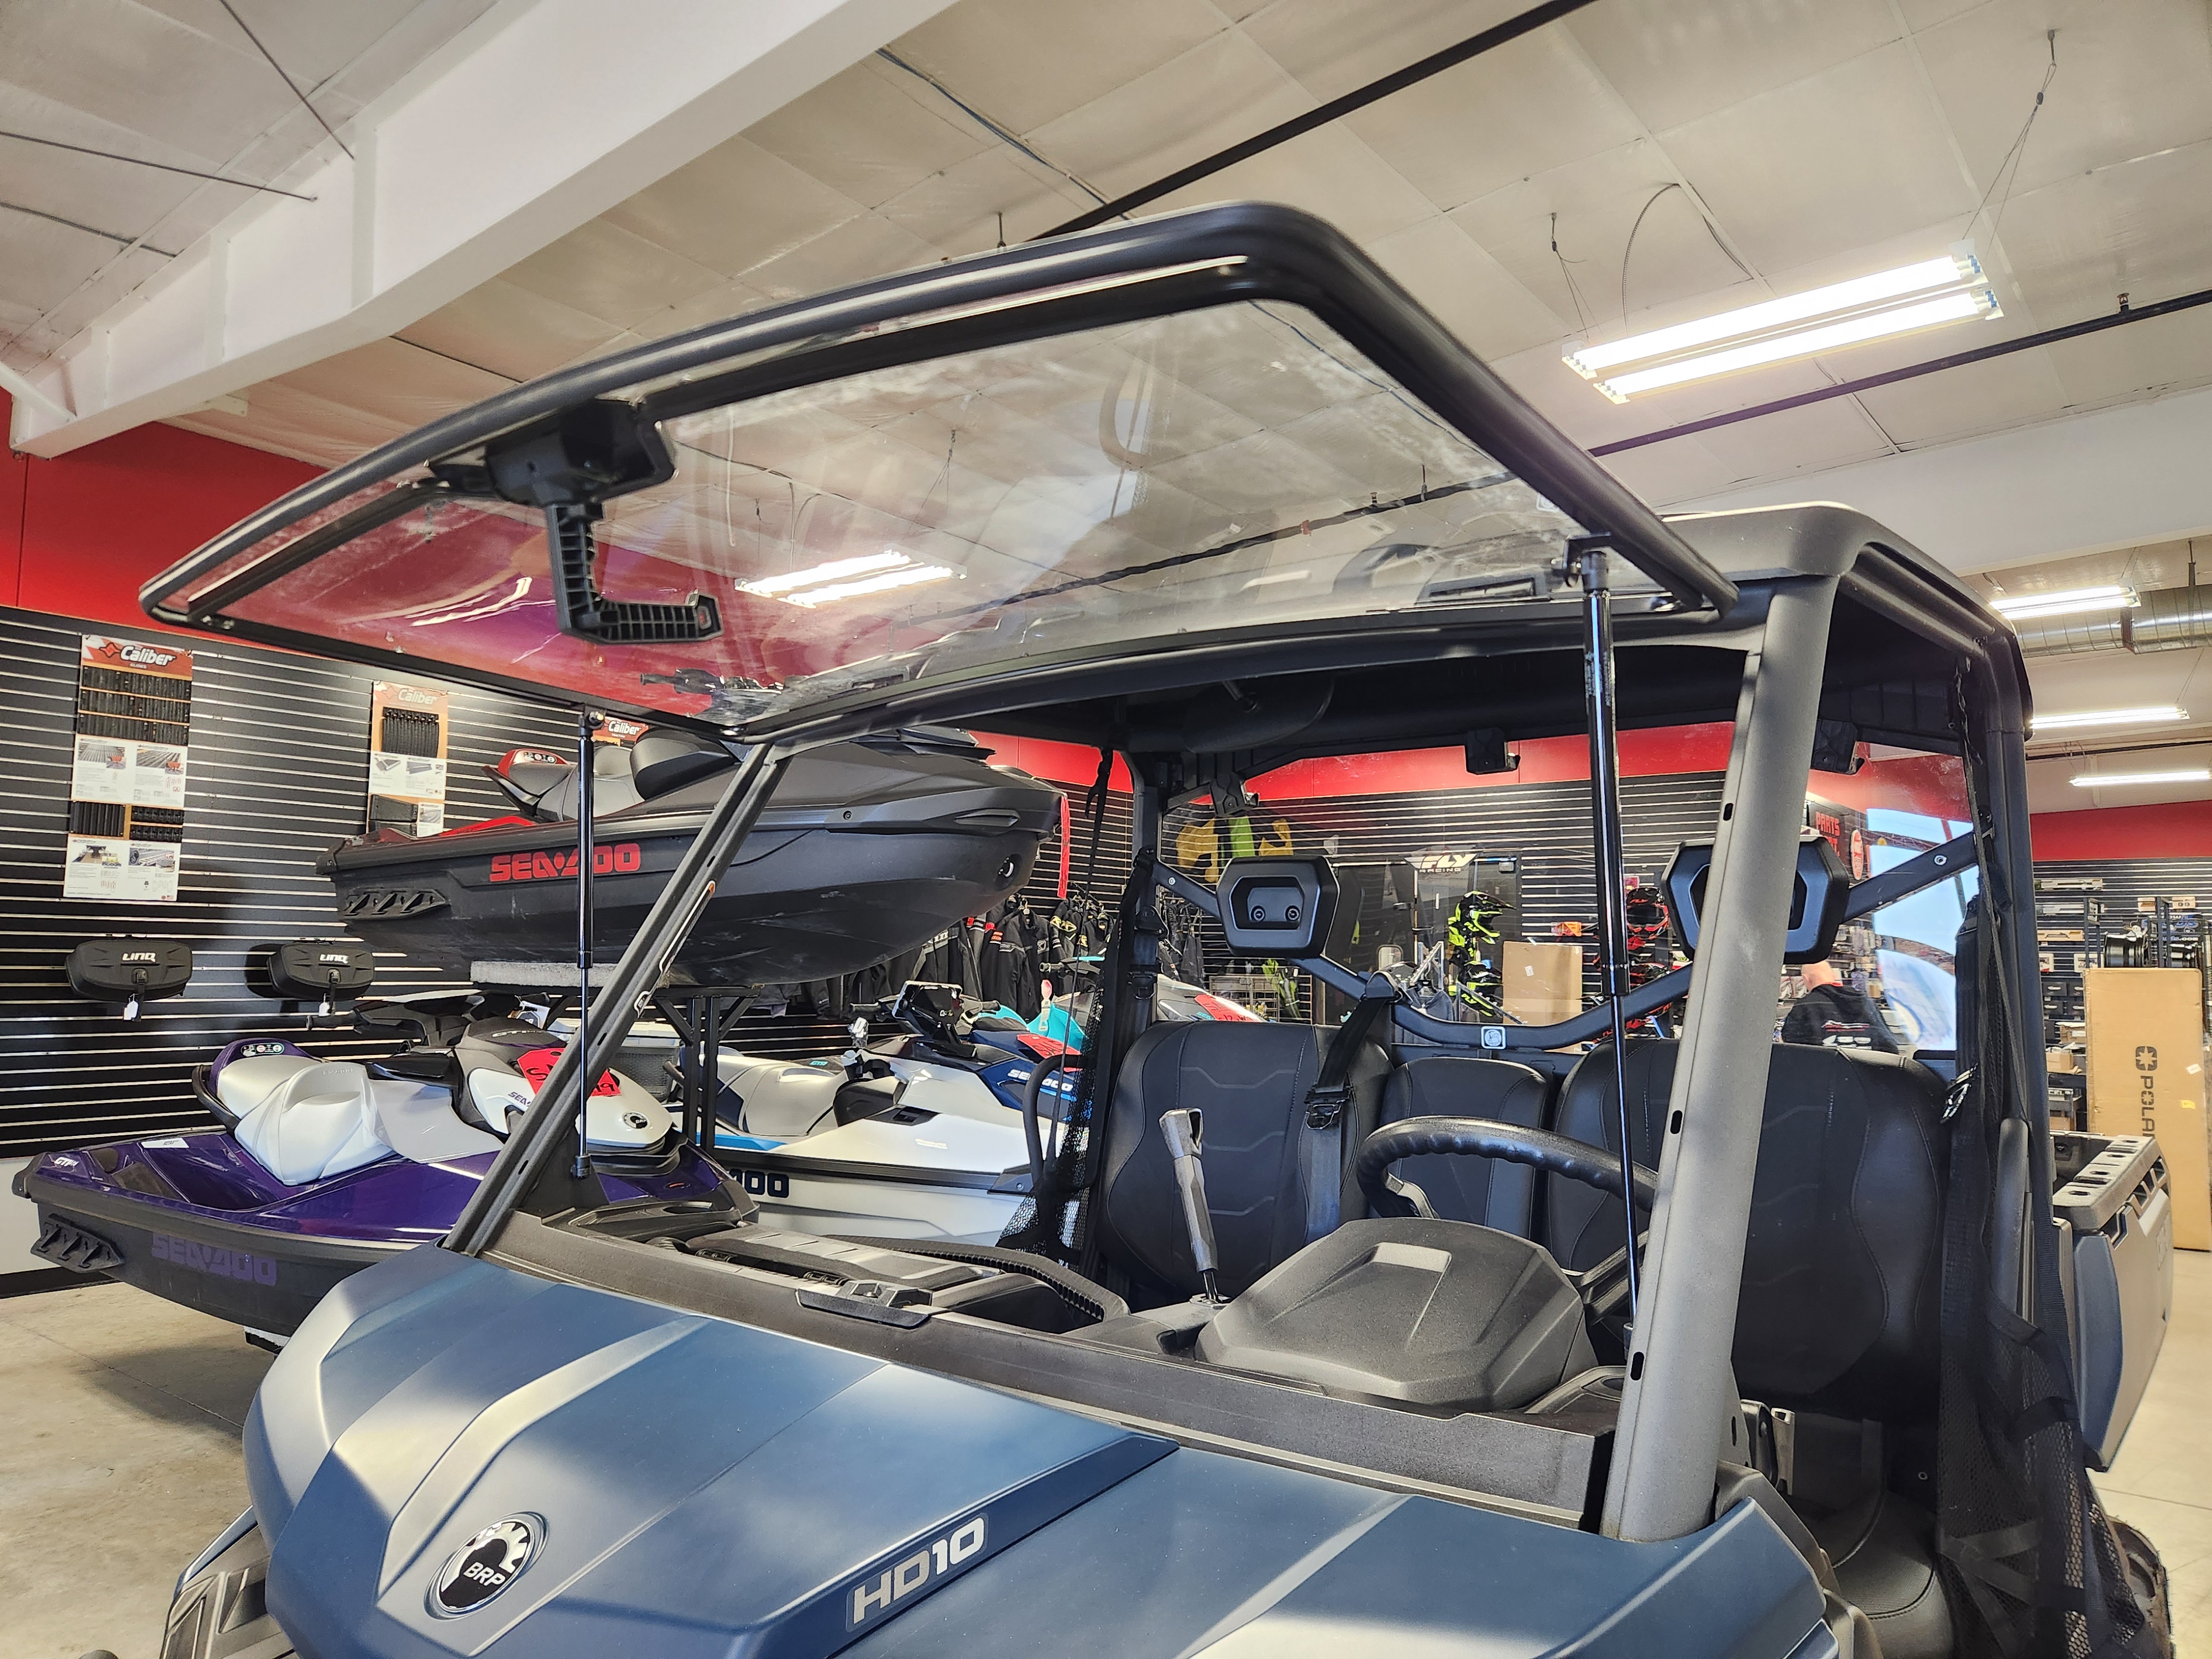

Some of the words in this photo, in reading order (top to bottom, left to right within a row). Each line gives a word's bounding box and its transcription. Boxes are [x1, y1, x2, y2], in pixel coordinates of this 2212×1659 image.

[120, 645, 176, 666] Caliber
[398, 687, 440, 705] Caliber
[608, 720, 641, 735] Caliber
[1815, 811, 1840, 836] PARTS
[463, 1562, 506, 1586] BRP
[853, 1517, 984, 1624] HD10
